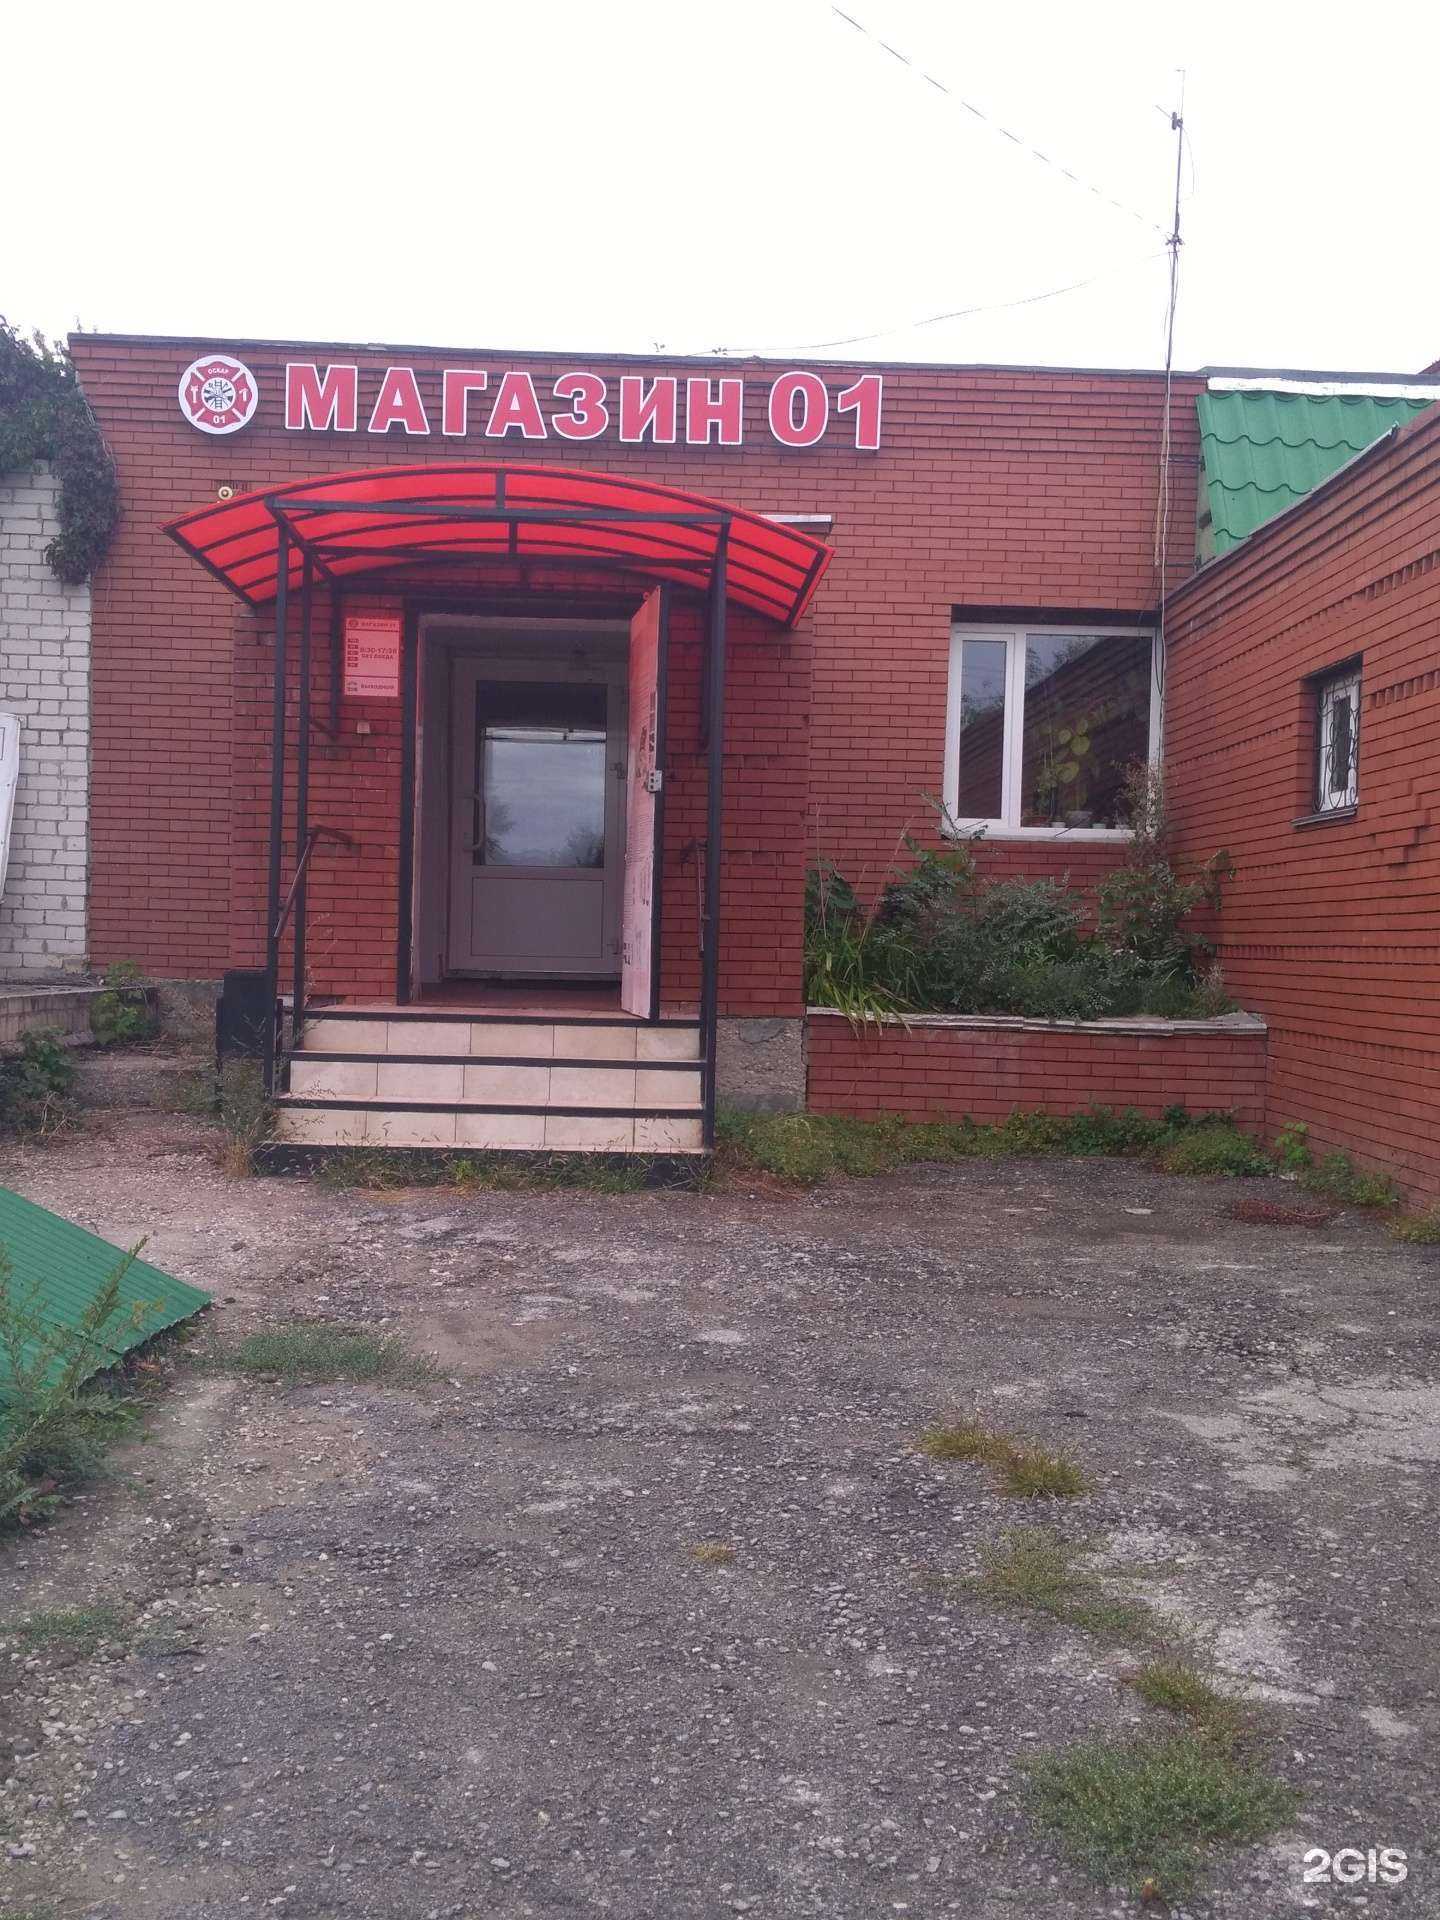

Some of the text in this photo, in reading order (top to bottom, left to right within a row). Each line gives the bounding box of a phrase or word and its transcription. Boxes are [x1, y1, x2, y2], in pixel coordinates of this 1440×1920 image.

[213, 415, 226, 424] 01
[285, 362, 883, 450] МАГАЗИН 01
